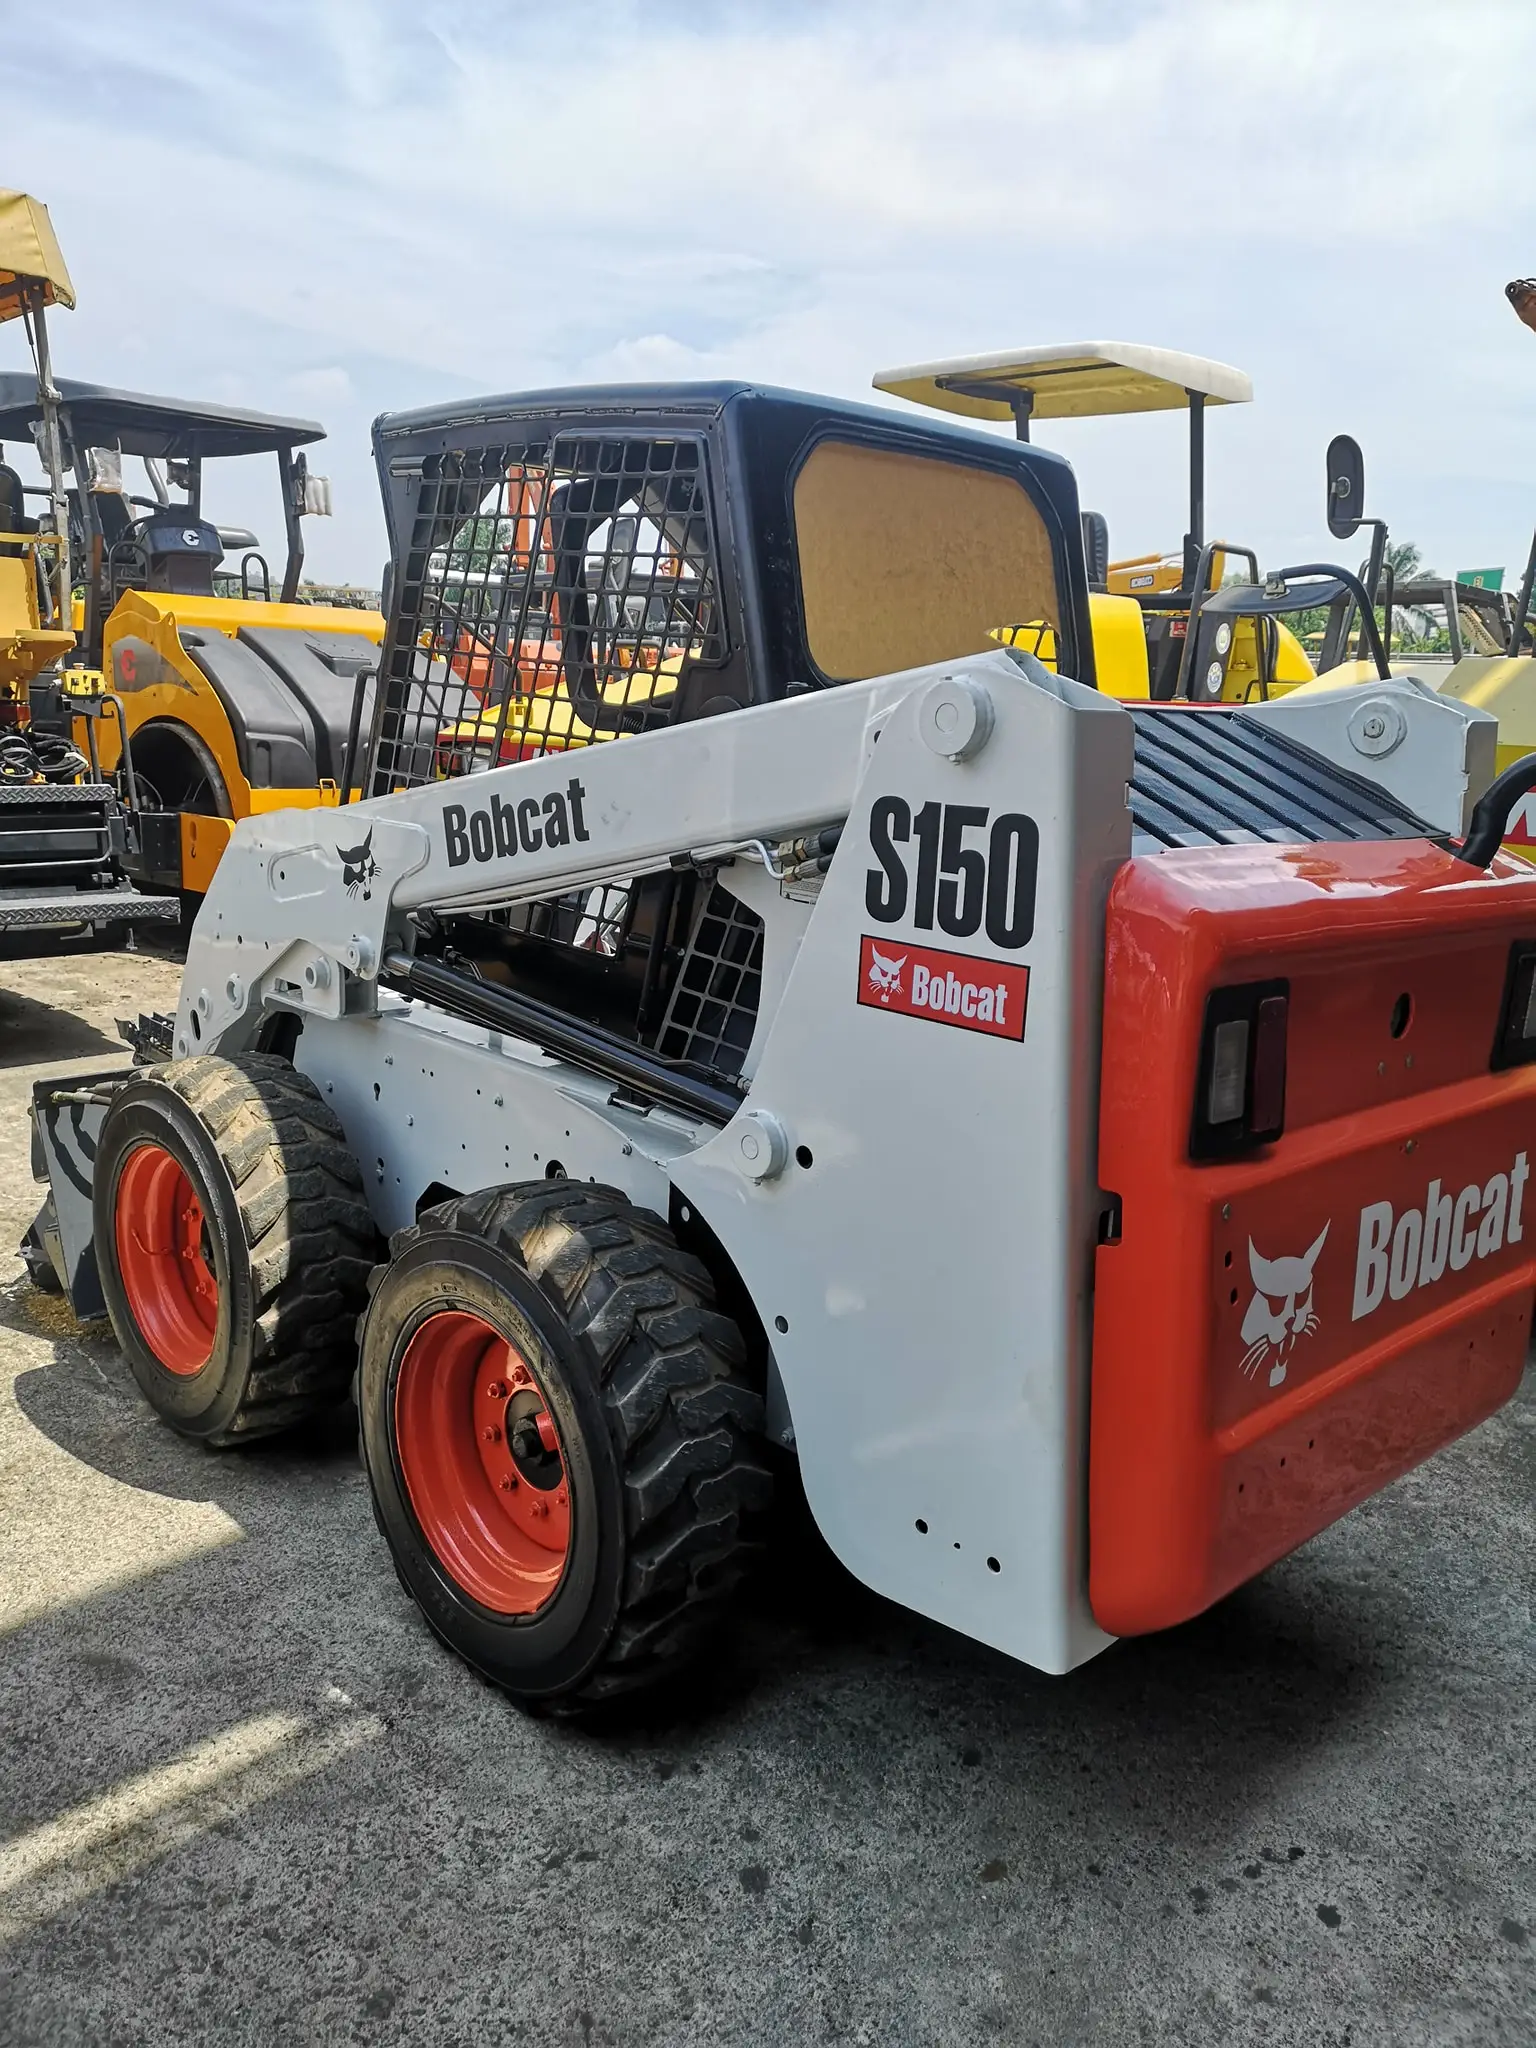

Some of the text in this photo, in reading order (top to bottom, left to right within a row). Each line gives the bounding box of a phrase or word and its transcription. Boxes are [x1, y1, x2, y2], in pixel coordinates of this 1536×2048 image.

[442, 777, 590, 868] Bobcat
[865, 795, 1040, 950] S150
[911, 964, 1008, 1025] Bobcat
[1352, 1151, 1530, 1322] Bobcat
